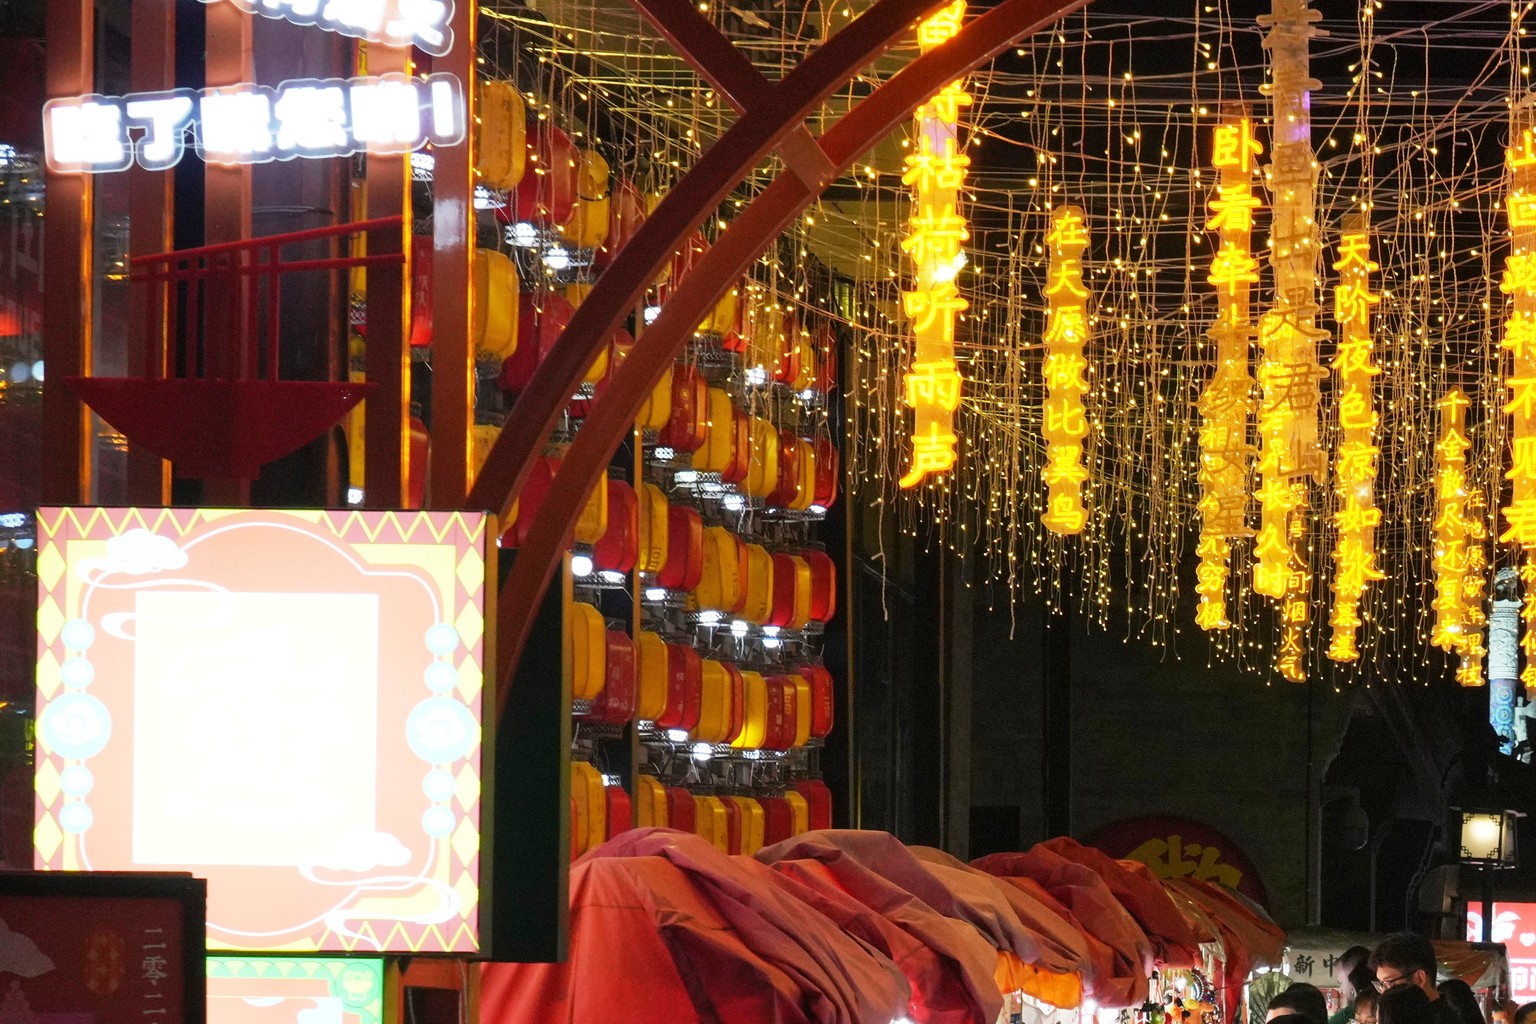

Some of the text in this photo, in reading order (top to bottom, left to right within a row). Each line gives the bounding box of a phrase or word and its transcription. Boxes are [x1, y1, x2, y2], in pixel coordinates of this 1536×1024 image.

[1046, 209, 1091, 532] 在天愿做比翼鸟
[1332, 232, 1388, 582] 天阶夜色凉如水
[1432, 390, 1468, 651] 千金散尽还复来
